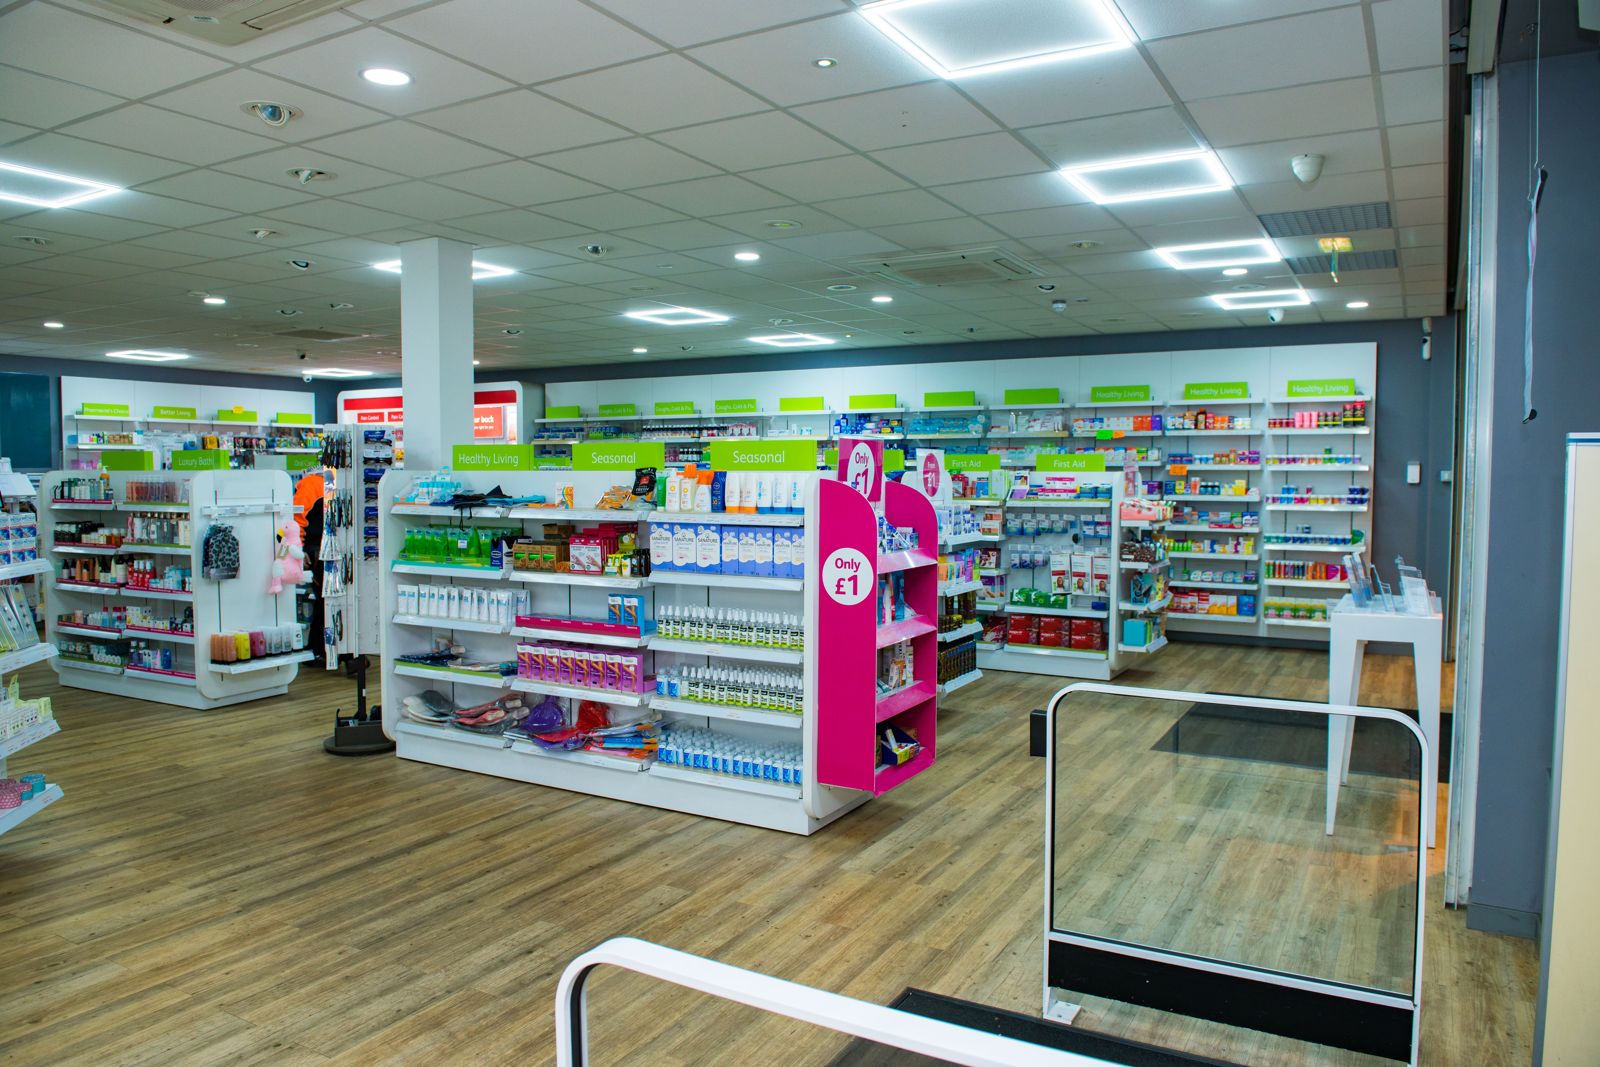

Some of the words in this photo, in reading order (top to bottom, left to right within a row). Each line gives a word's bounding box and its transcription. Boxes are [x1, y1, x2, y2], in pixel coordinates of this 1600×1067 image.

[1190, 388, 1219, 397] Healthy
[1220, 387, 1242, 396] Living
[1292, 384, 1322, 394] Healthy
[1325, 384, 1349, 393] Living
[1096, 391, 1122, 399] Healthy
[1123, 390, 1145, 399] Living
[481, 415, 495, 423] back
[458, 453, 490, 467] Healthy
[493, 453, 519, 467] Living
[591, 451, 636, 464] Seasonal
[733, 450, 785, 463] Seasonal
[855, 451, 869, 467] Only
[178, 457, 198, 467] Luxury
[952, 459, 968, 468] First
[968, 459, 982, 468] Aid
[1053, 460, 1070, 468] First
[1070, 459, 1086, 468] Aid
[834, 557, 861, 573] Only
[834, 574, 858, 596] £1
